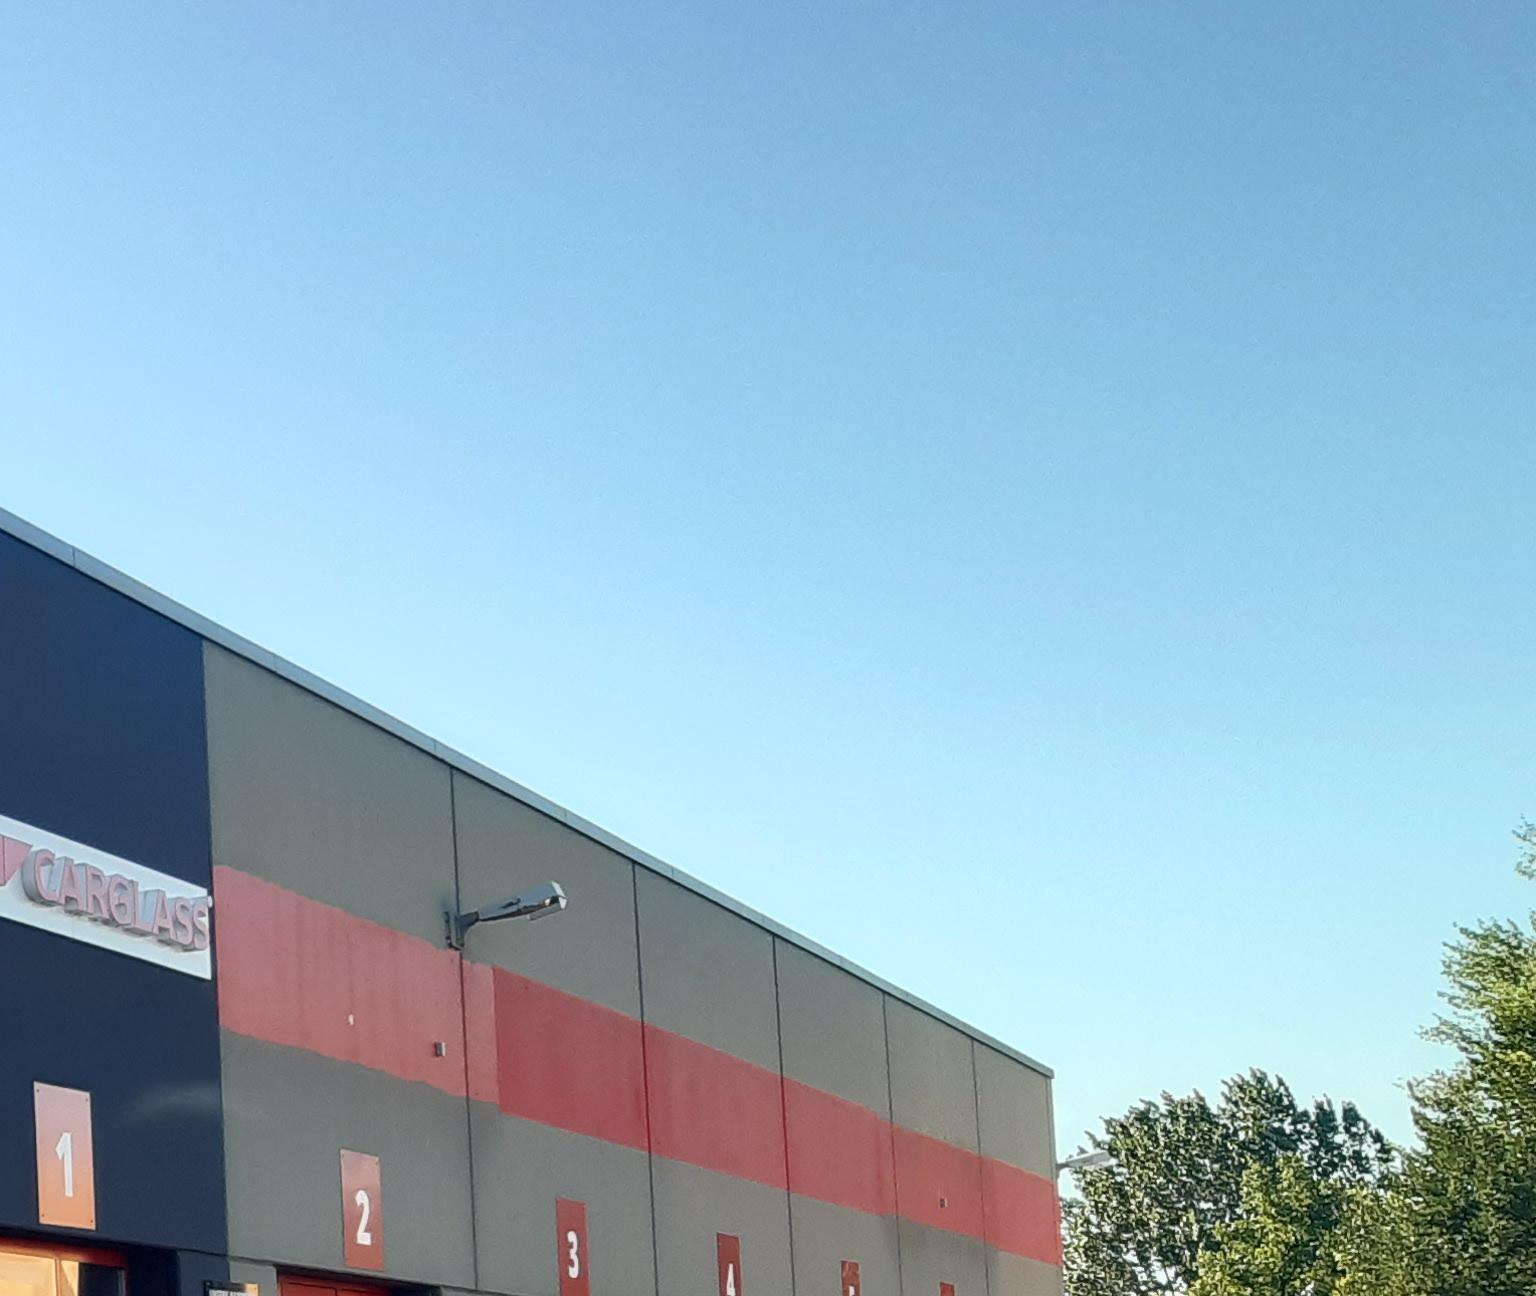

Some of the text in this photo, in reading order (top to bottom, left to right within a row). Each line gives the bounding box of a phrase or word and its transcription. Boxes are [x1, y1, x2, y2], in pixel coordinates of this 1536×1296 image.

[23, 848, 209, 951] CARGLASS
[55, 1131, 75, 1198] 1
[355, 1188, 373, 1245] 2
[566, 1230, 580, 1280] 3
